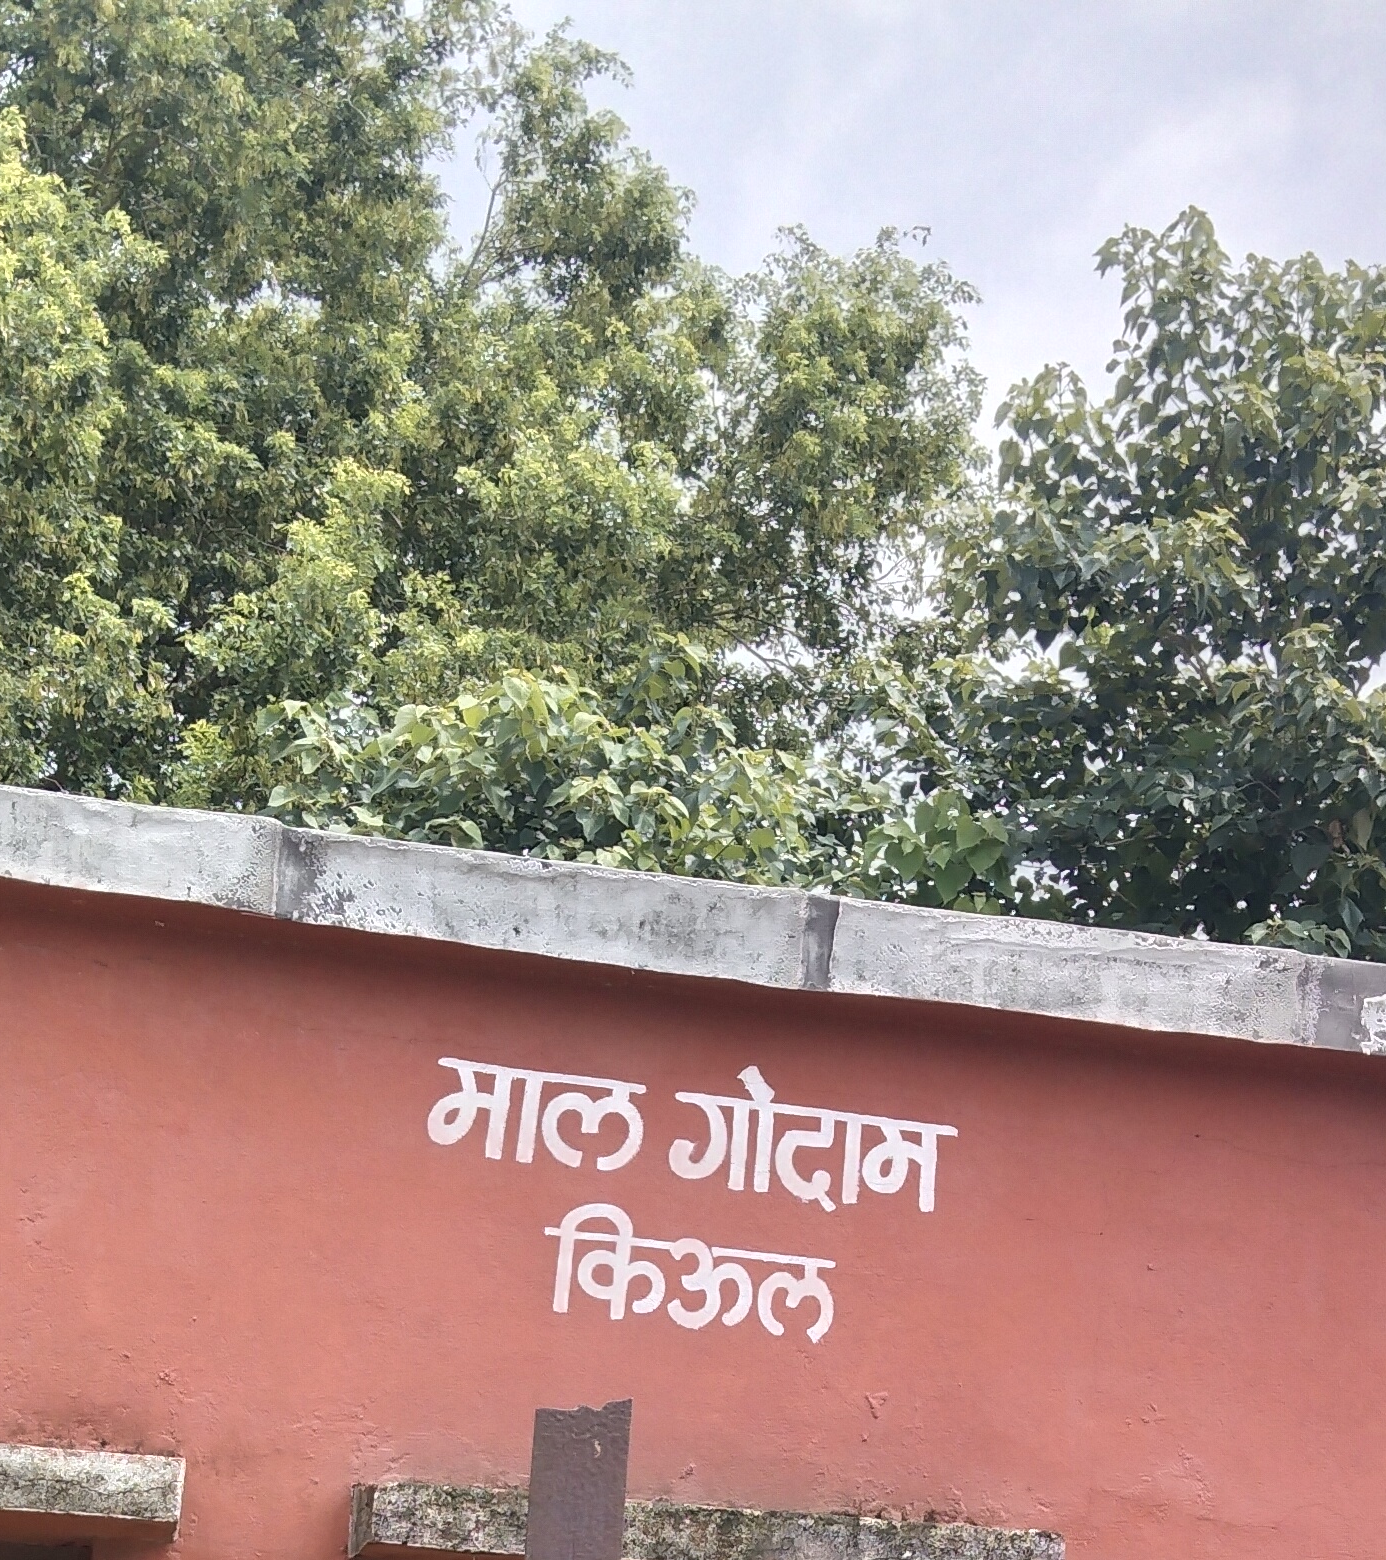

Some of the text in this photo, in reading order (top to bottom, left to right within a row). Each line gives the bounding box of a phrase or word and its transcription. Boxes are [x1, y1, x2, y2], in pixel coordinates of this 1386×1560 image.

[426, 1056, 959, 1213] माल गोदाम
[543, 1202, 837, 1344] किऊल
